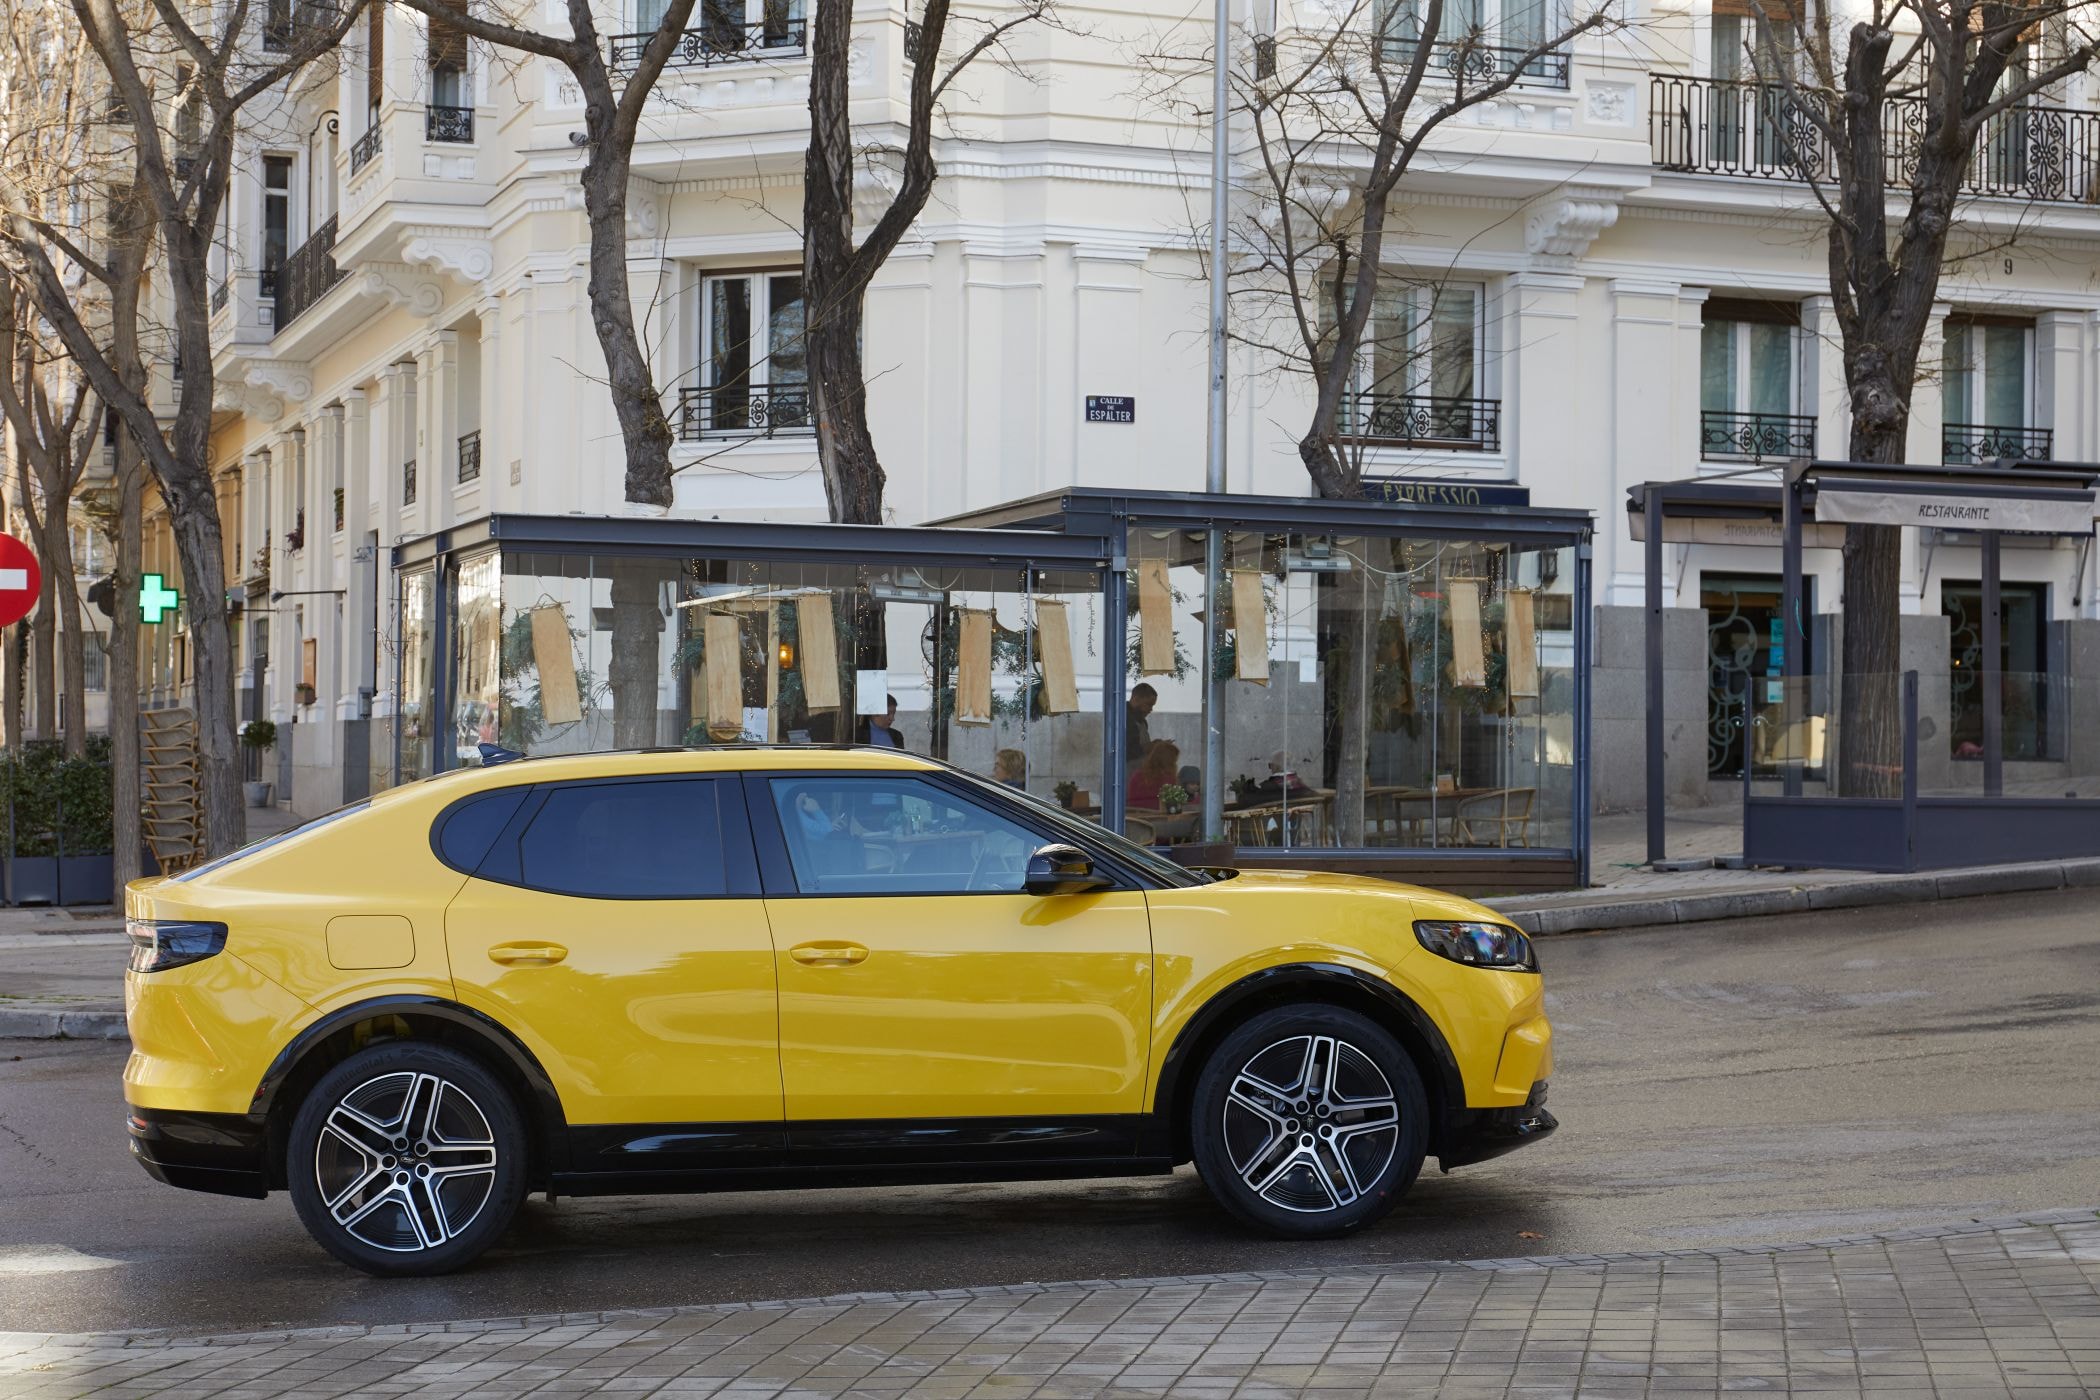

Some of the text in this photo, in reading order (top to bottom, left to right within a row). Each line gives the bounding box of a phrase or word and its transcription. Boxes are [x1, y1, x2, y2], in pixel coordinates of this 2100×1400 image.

[2004, 258, 2013, 275] 9
[1100, 397, 1124, 405] CALLE
[1090, 410, 1131, 421] ESPALTER
[1918, 504, 1990, 520] RESTAURANTE
